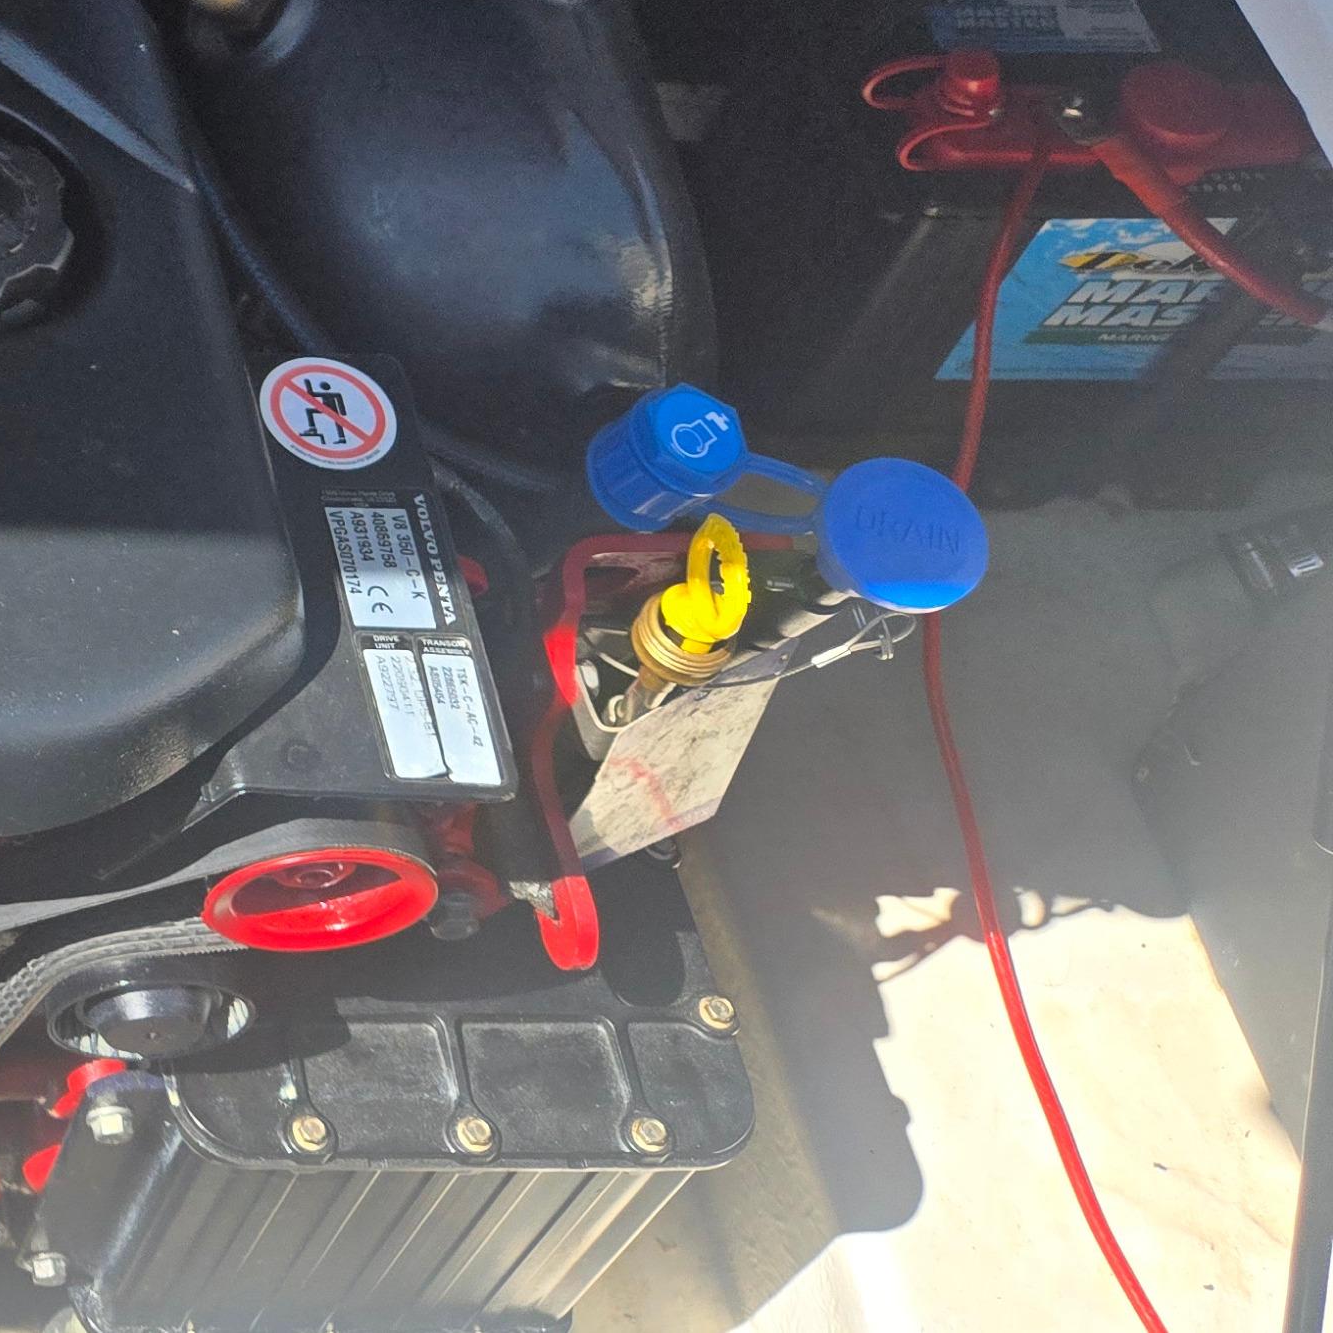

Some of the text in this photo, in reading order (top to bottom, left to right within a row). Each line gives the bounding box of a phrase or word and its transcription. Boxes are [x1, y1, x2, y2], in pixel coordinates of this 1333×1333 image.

[349, 510, 376, 562] A931934
[371, 511, 398, 569] 40869758
[391, 514, 408, 530] V8
[852, 504, 962, 556] DRAIN
[328, 510, 363, 594] VPGAS070174
[414, 493, 456, 626] VOLVO PENTA
[372, 634, 400, 643] DRIVE
